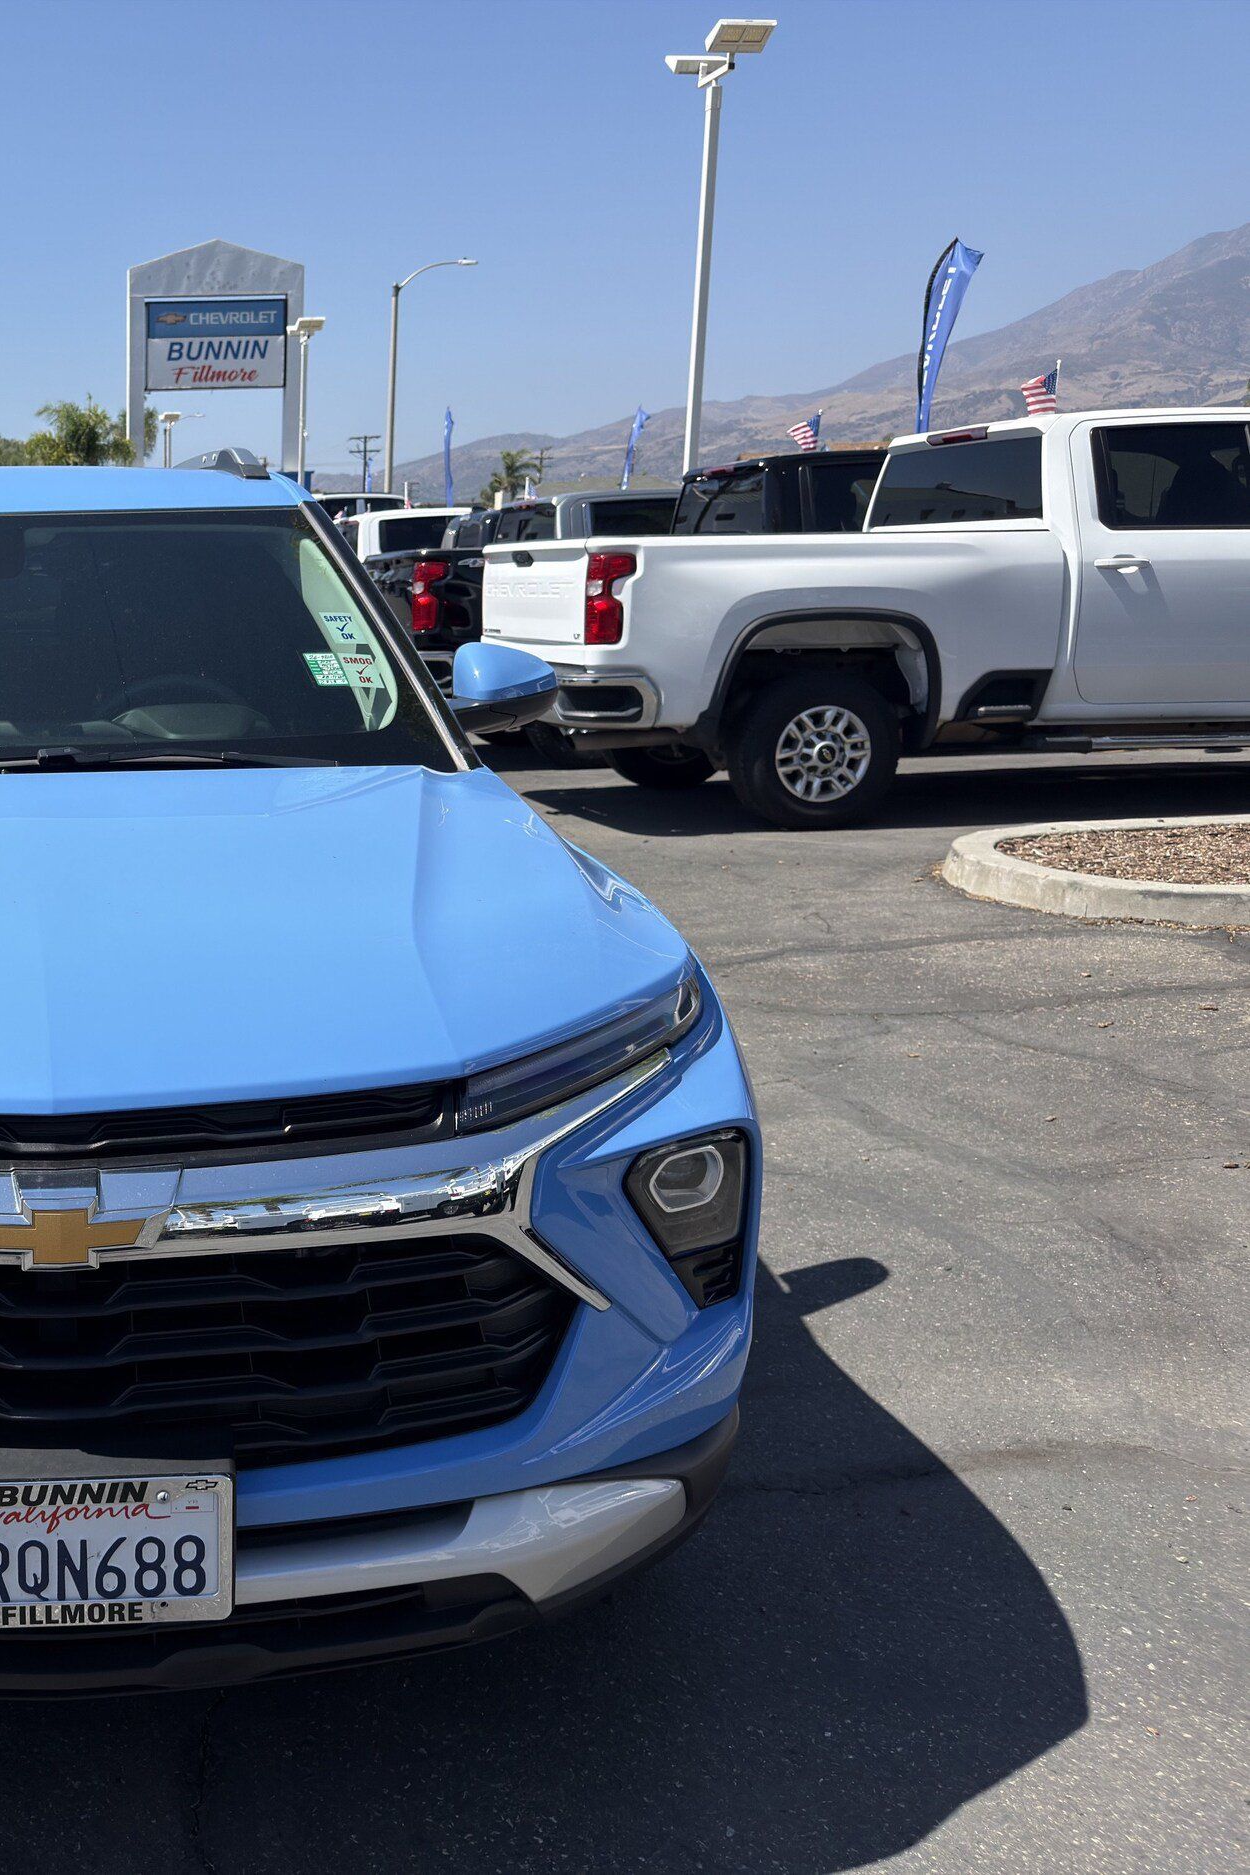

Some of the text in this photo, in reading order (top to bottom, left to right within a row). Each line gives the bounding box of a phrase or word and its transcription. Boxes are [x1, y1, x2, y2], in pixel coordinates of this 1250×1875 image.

[189, 311, 277, 326] CHEVROLET
[167, 340, 269, 362] BUNNIN
[172, 365, 260, 384] Fillmore
[343, 657, 372, 665] SMOG
[359, 676, 373, 684] OK
[1, 1601, 143, 1626] FILLMORE
